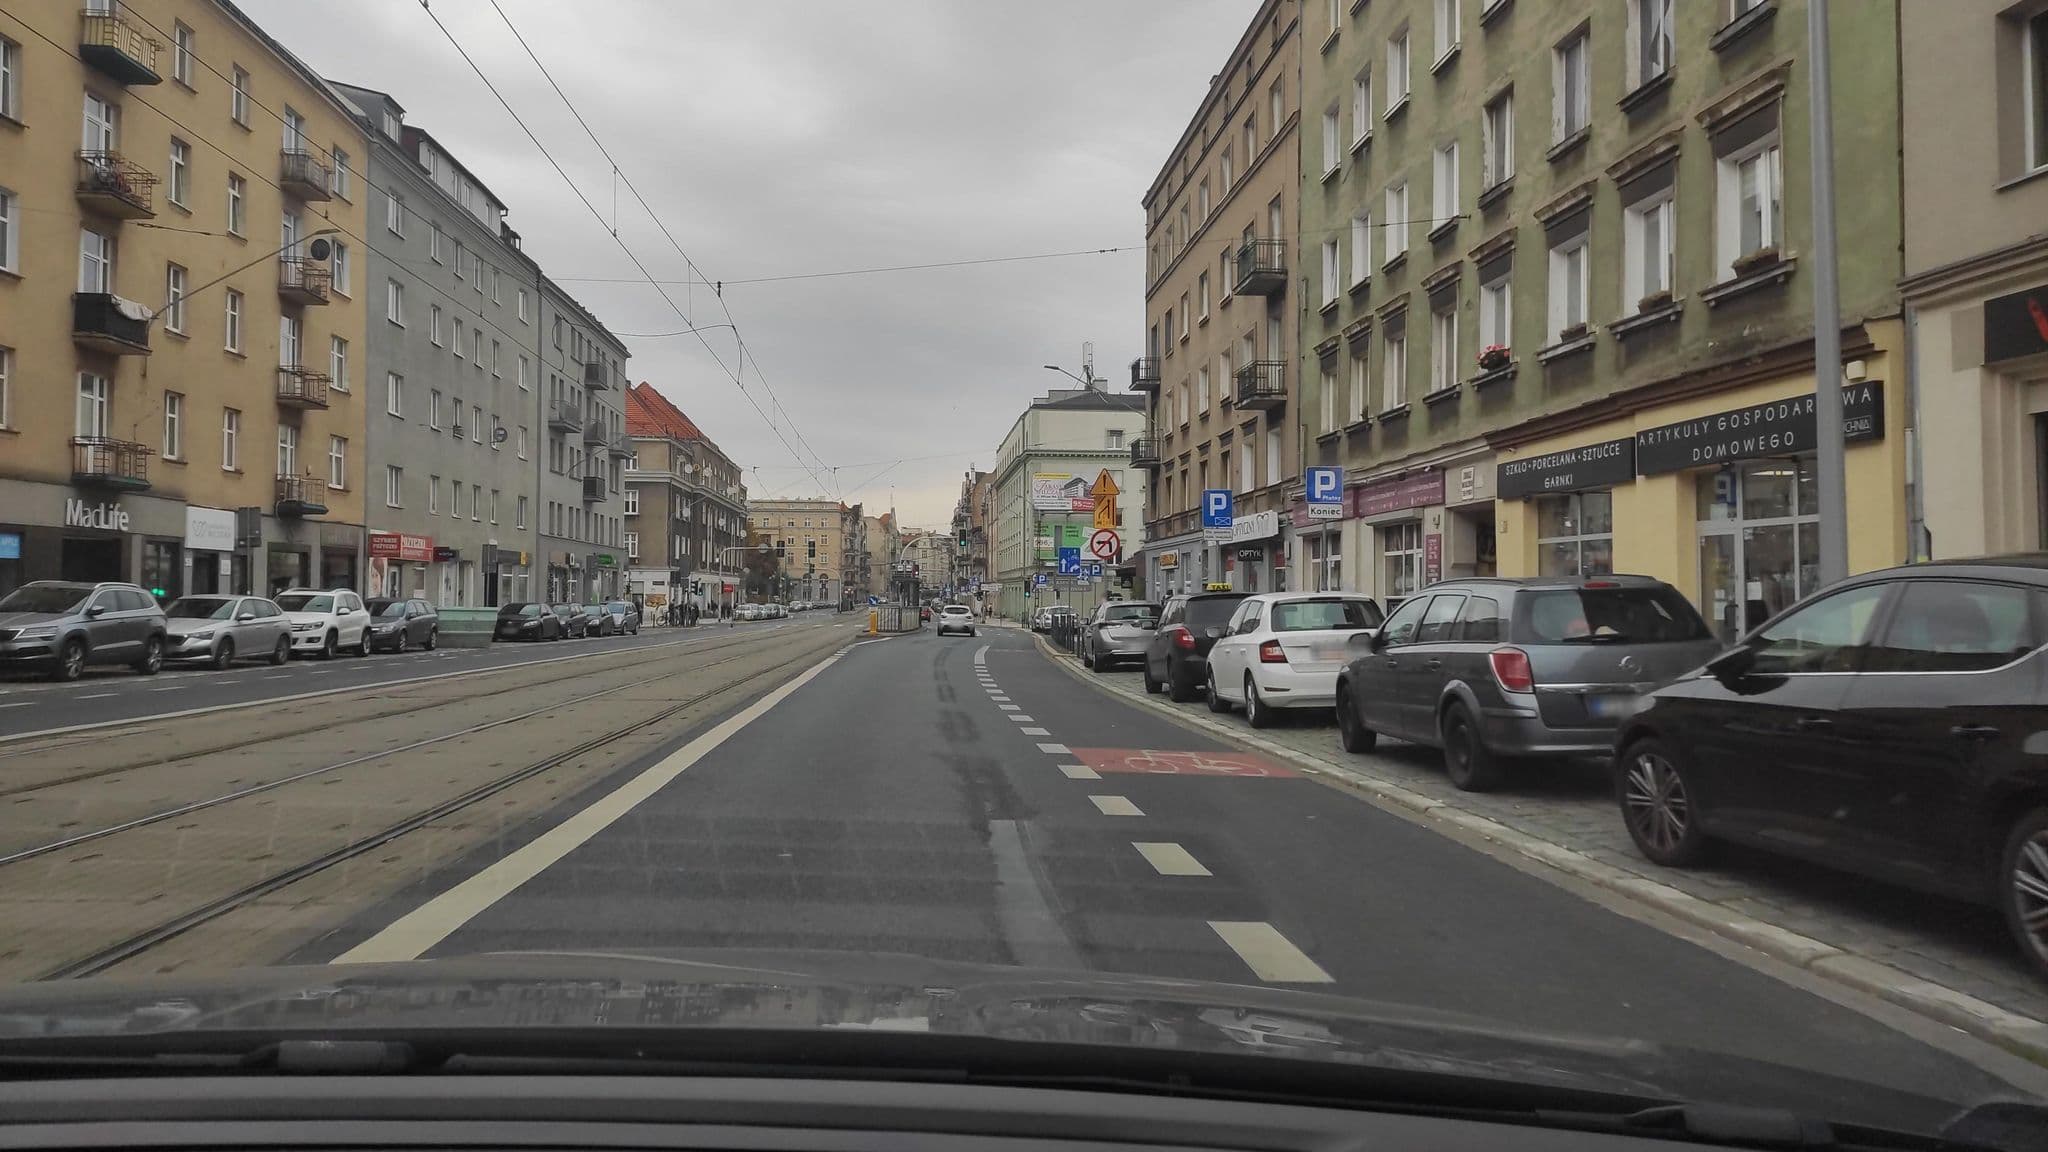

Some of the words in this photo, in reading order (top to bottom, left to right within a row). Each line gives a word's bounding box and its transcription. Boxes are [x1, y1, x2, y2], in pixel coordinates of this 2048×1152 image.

[1718, 388, 1871, 431] GOSPODARWA
[1692, 431, 1794, 461] DOMOWEGO
[1532, 453, 1576, 470] PORCELANA
[1315, 470, 1336, 499] P
[1544, 474, 1573, 489] GARNKI
[1210, 493, 1227, 516] P
[1310, 506, 1341, 515] Koniec
[66, 498, 129, 531] MacLife
[1239, 549, 1261, 557] OPTYK
[1093, 565, 1101, 575] P
[1039, 575, 1046, 584] P
[1212, 584, 1230, 592] TAXI
